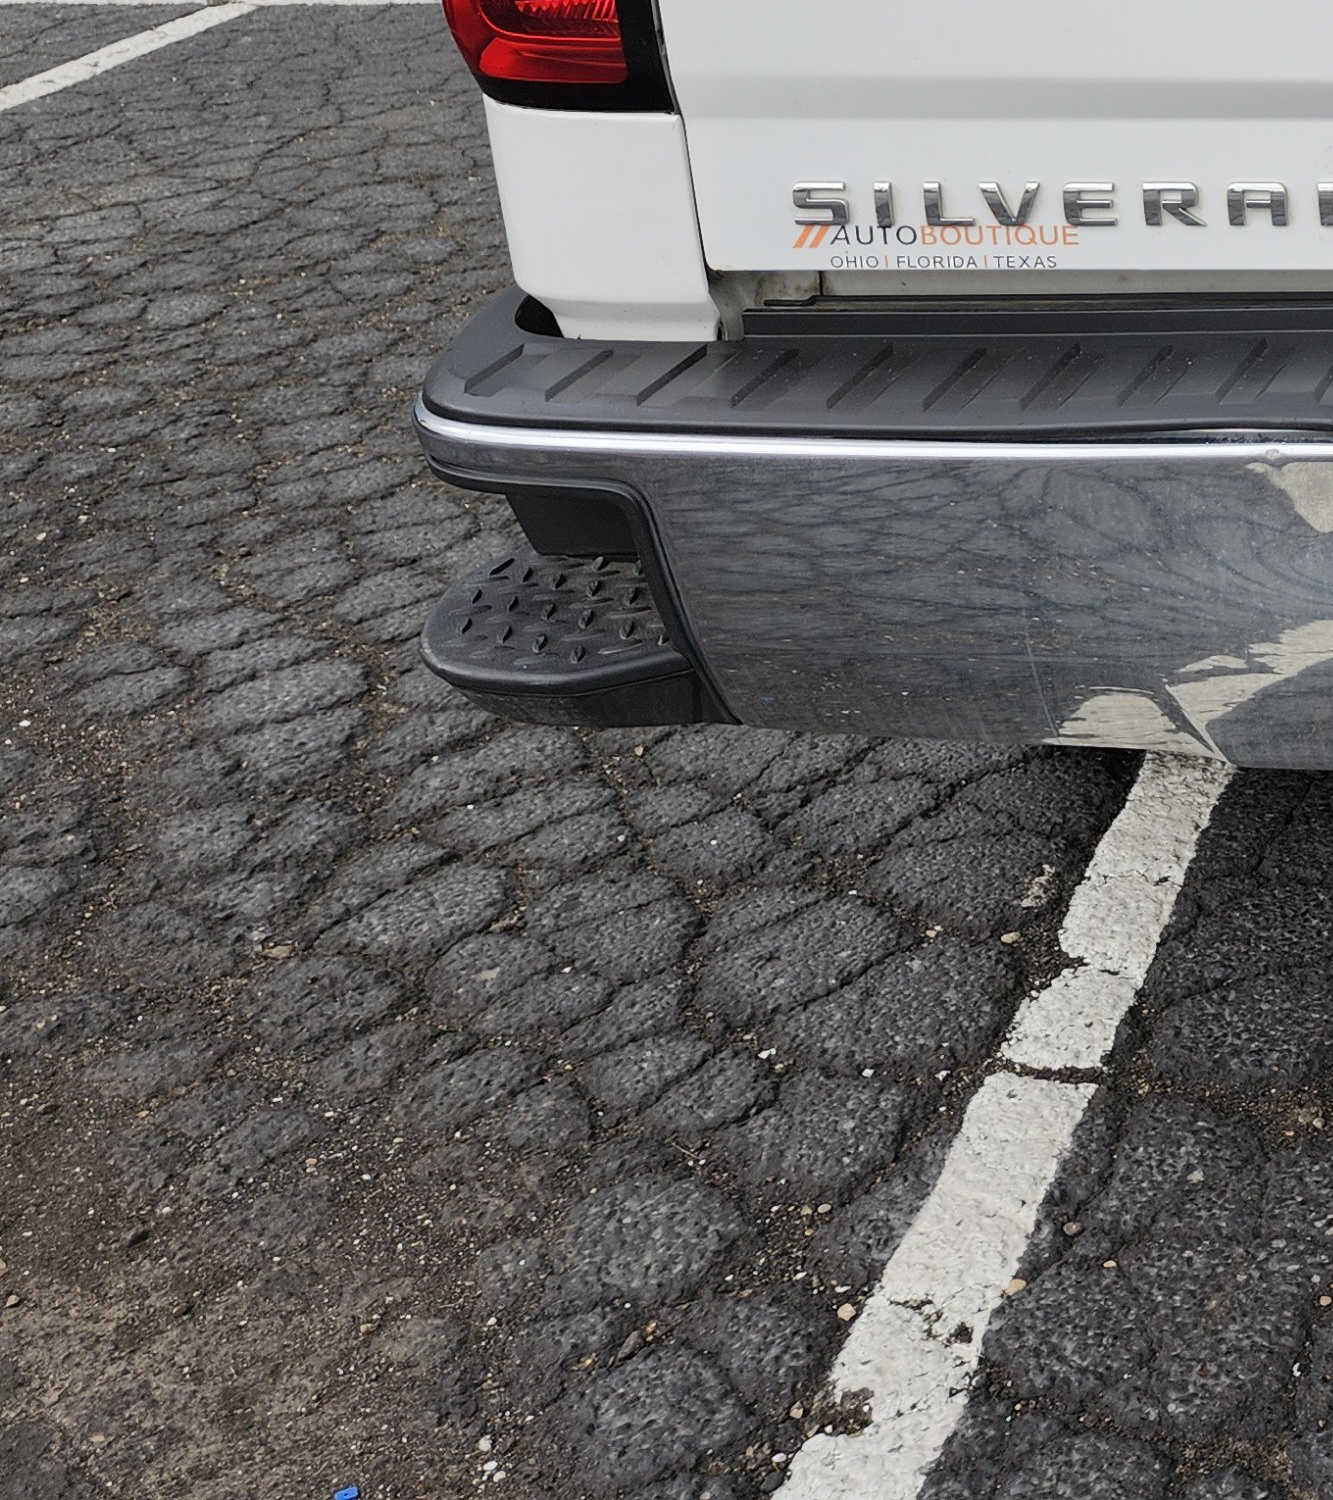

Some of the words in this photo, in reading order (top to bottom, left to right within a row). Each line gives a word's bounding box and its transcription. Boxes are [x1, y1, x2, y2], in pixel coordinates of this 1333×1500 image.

[830, 224, 1080, 246] AUTOBOUTIQUE
[830, 255, 879, 269] OHIO
[896, 255, 978, 269] FLORIDA
[993, 255, 1057, 269] TEXAS
